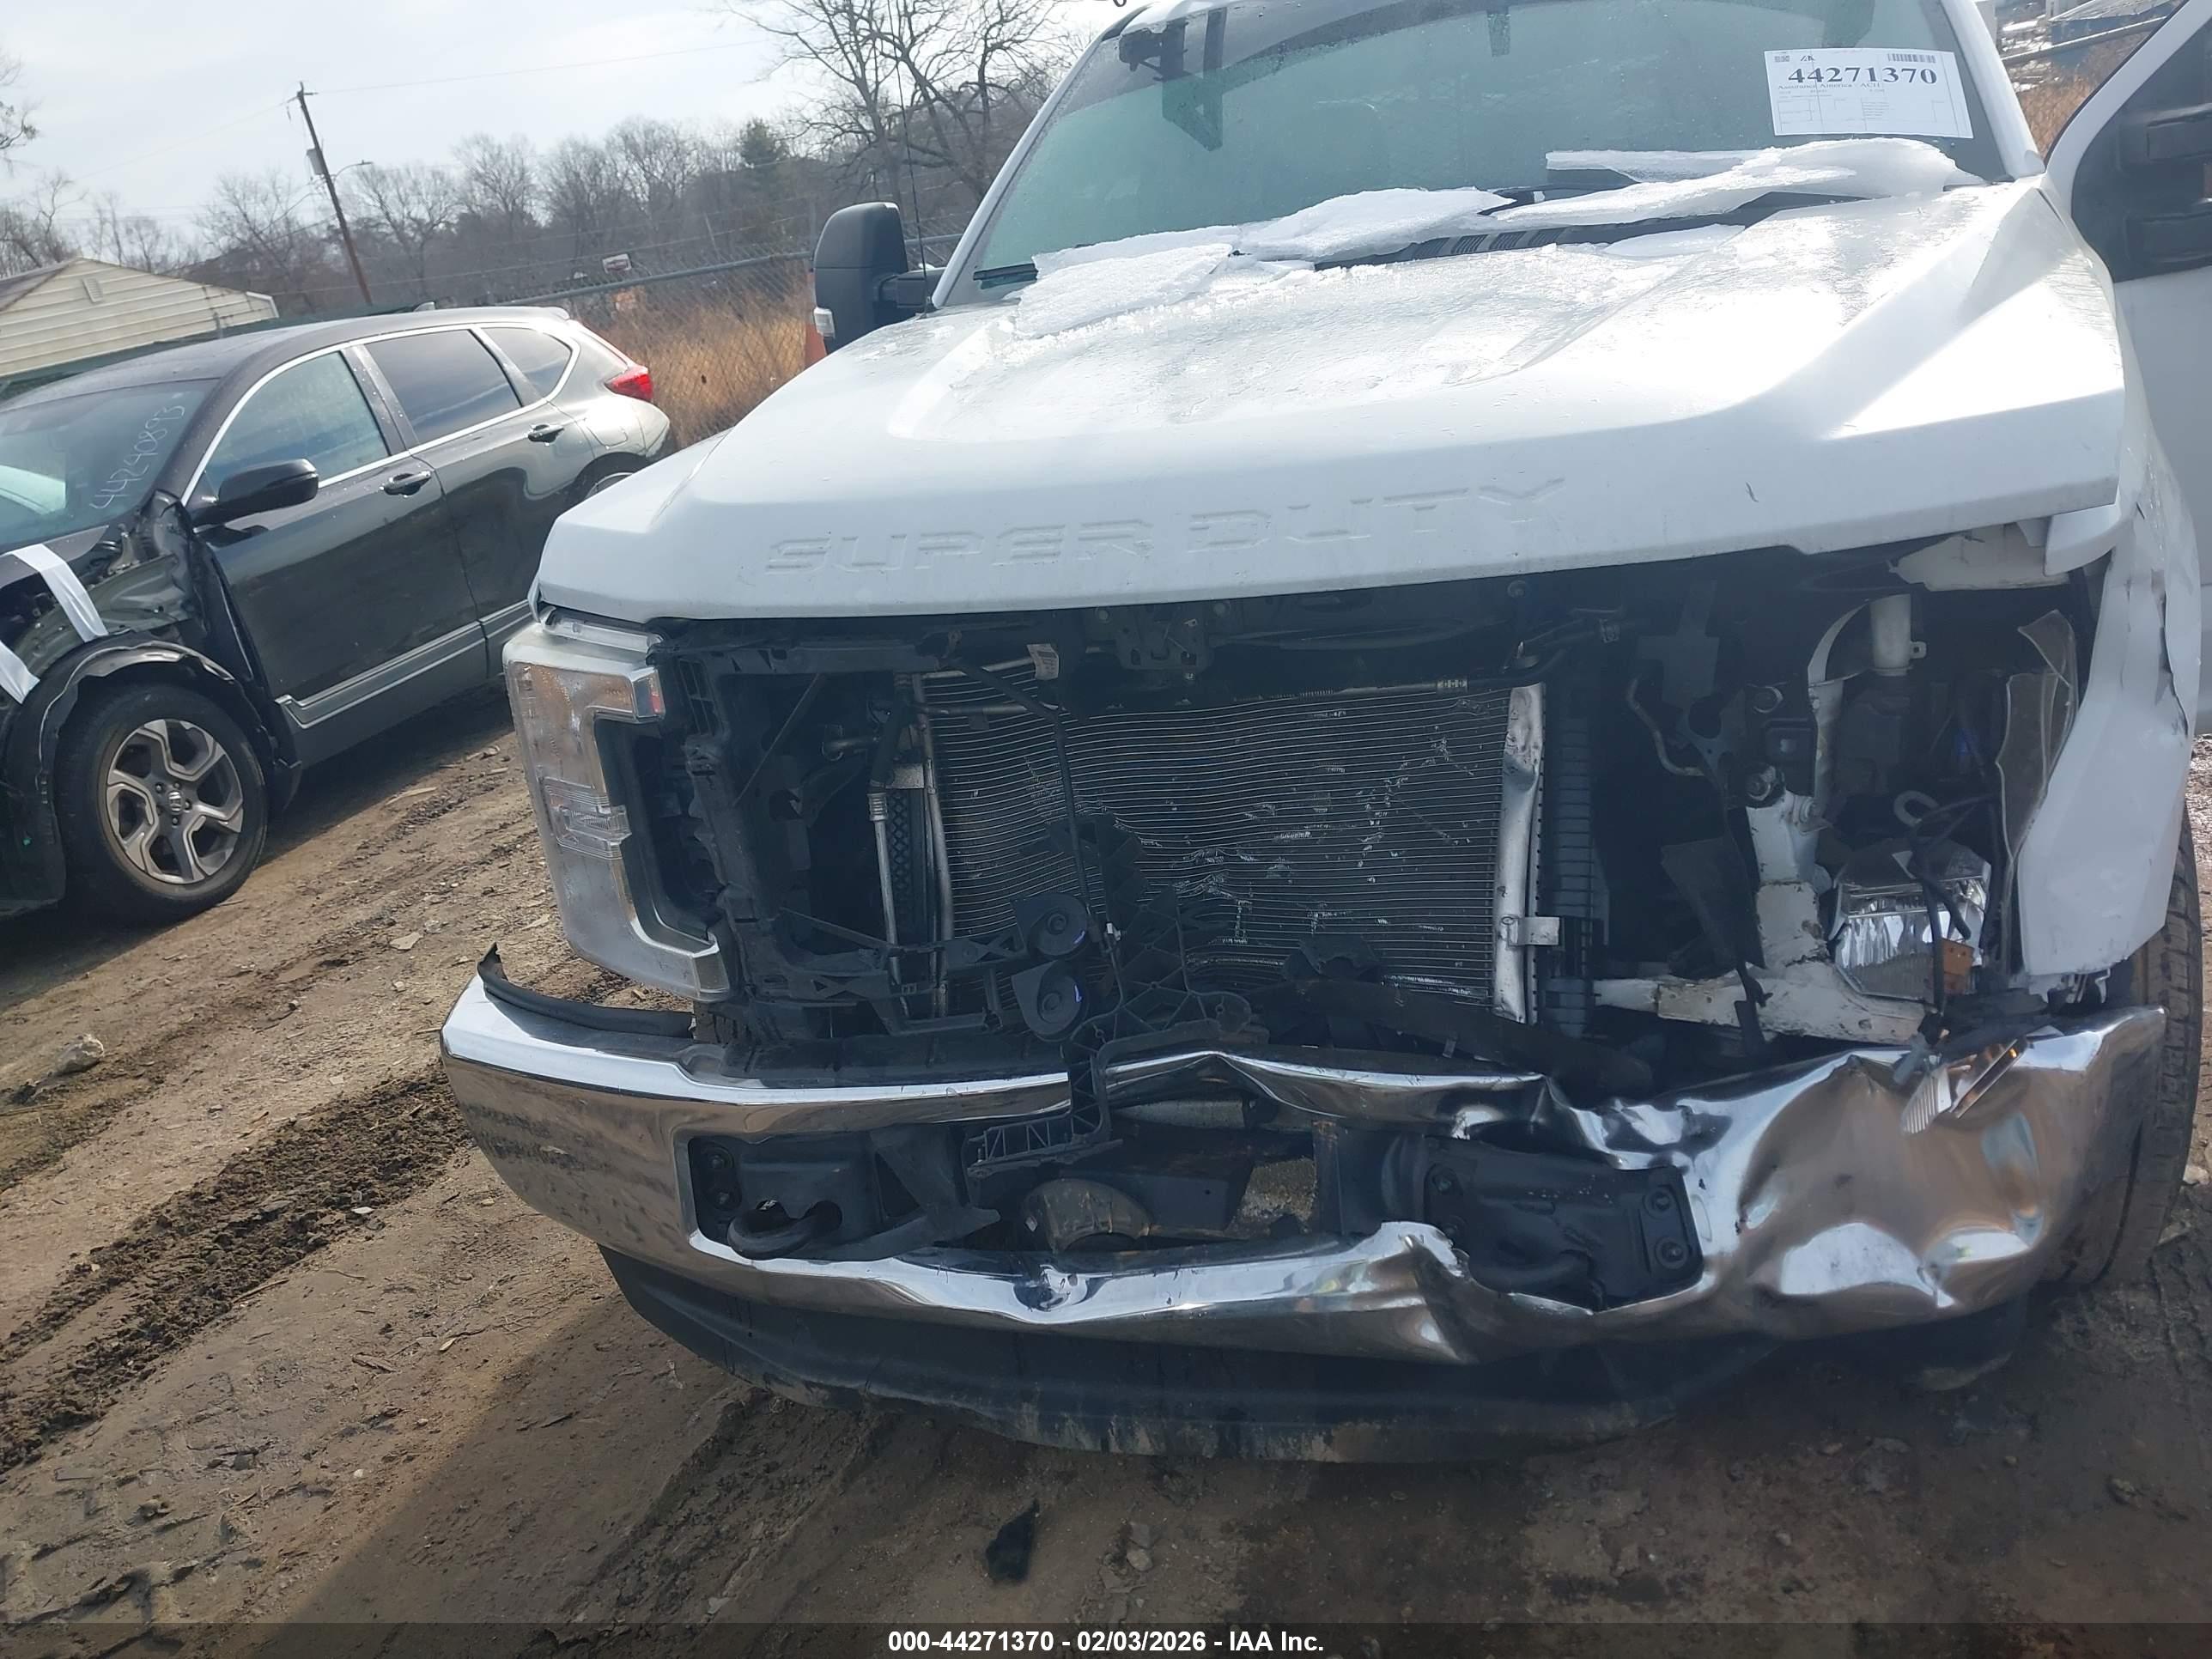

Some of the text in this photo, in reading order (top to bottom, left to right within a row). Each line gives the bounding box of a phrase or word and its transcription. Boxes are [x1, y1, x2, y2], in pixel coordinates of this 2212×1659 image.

[1788, 67, 1938, 84] 44271370
[764, 477, 1565, 574] SUPER DUTY
